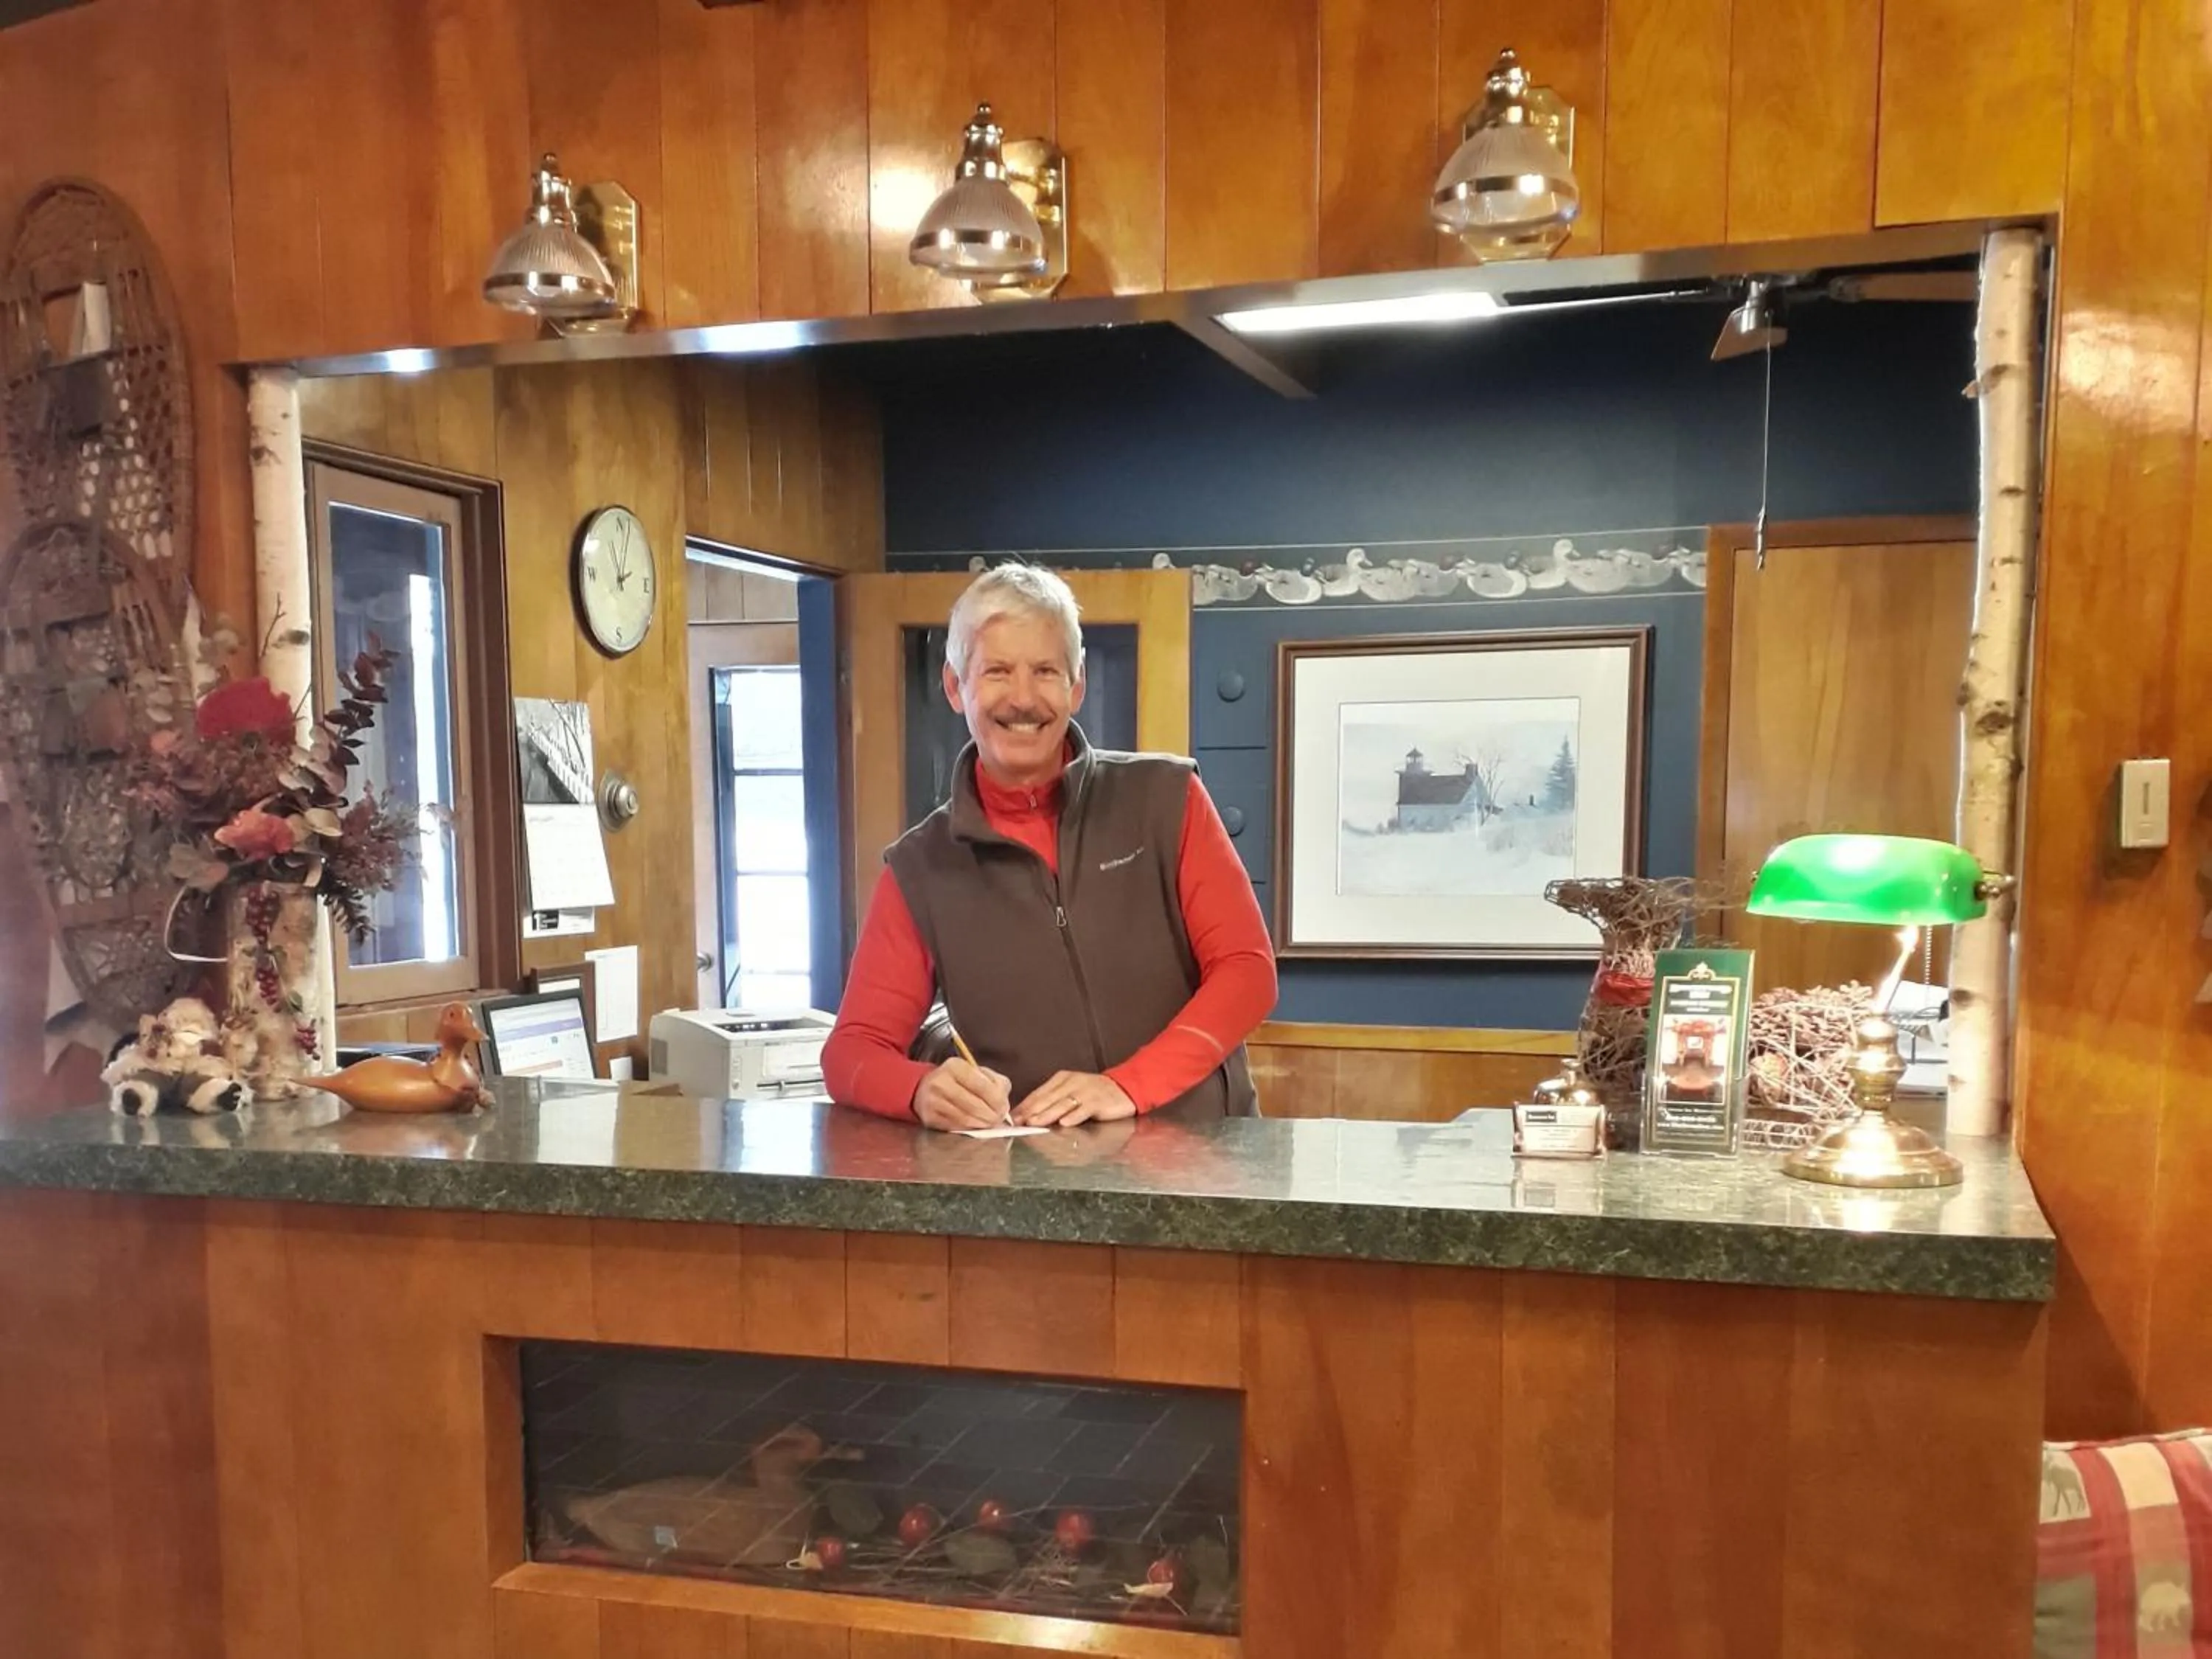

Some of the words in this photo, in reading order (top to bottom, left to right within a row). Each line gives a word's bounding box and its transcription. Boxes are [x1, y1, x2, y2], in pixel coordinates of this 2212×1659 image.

[587, 566, 597, 582] W
[642, 577, 650, 594] E
[615, 627, 622, 642] S
